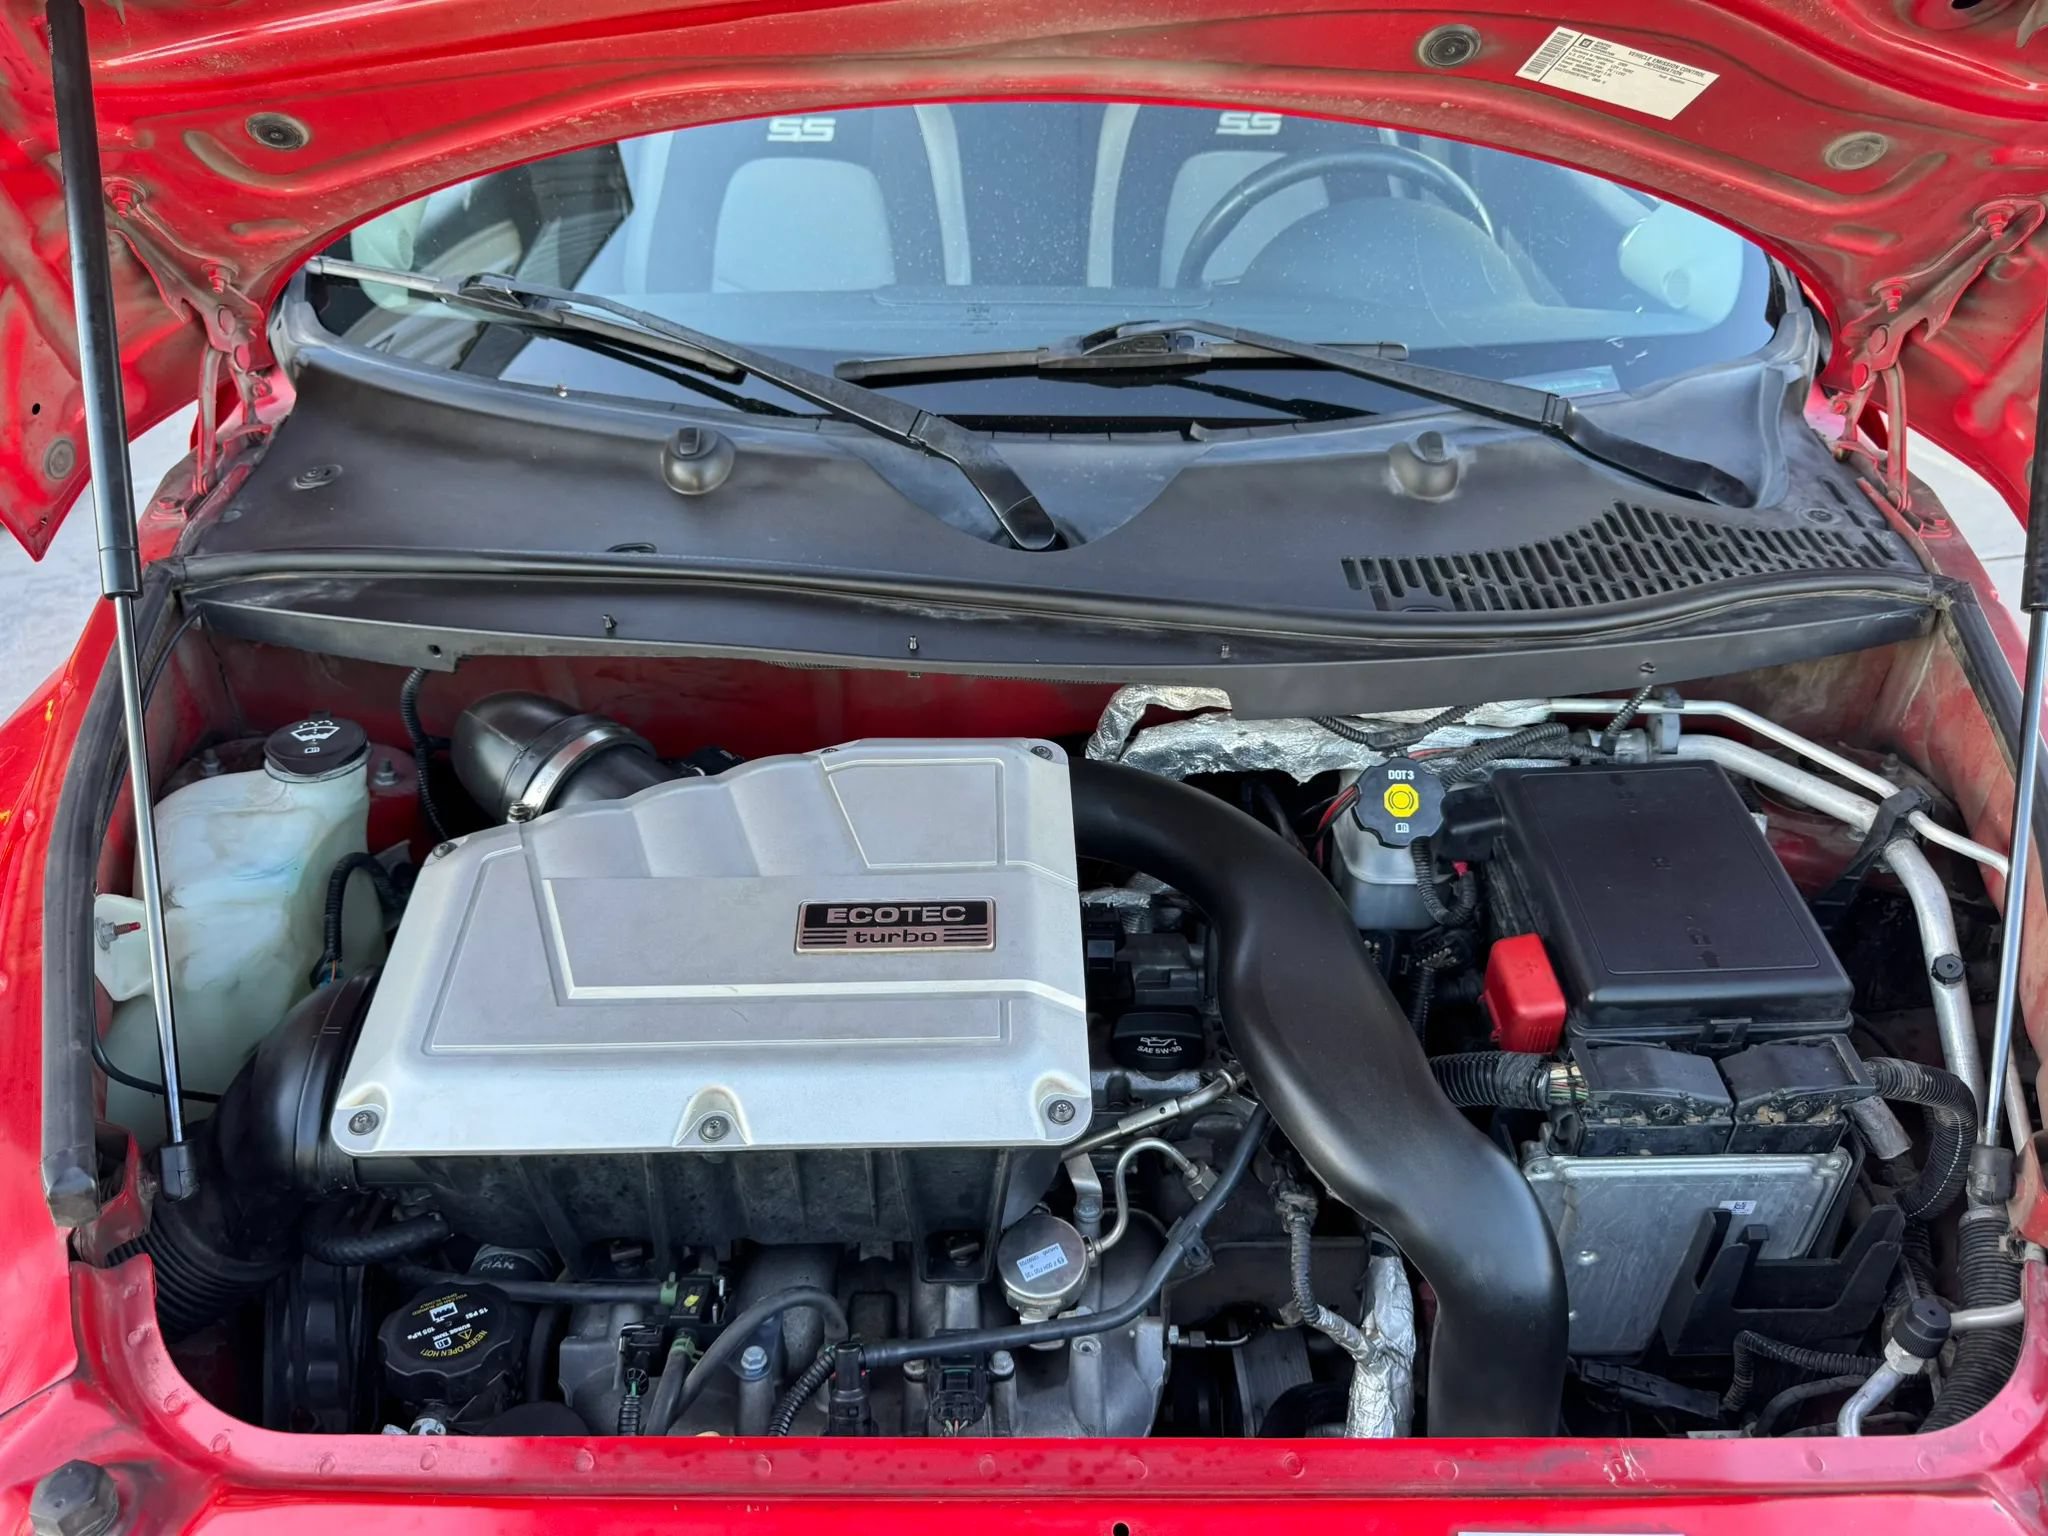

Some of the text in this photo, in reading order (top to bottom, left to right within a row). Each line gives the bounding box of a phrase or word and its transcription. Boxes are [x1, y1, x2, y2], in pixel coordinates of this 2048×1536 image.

[767, 117, 836, 142] SS
[1215, 111, 1282, 135] SS
[826, 905, 966, 924] ECOTEC
[854, 929, 938, 944] turbo
[1136, 1045, 1183, 1054] SAE 5W-30
[465, 1307, 489, 1320] 15 PSI
[407, 1326, 436, 1340] 105 kPa
[420, 1330, 488, 1358] NEVER OPEN HOT!
